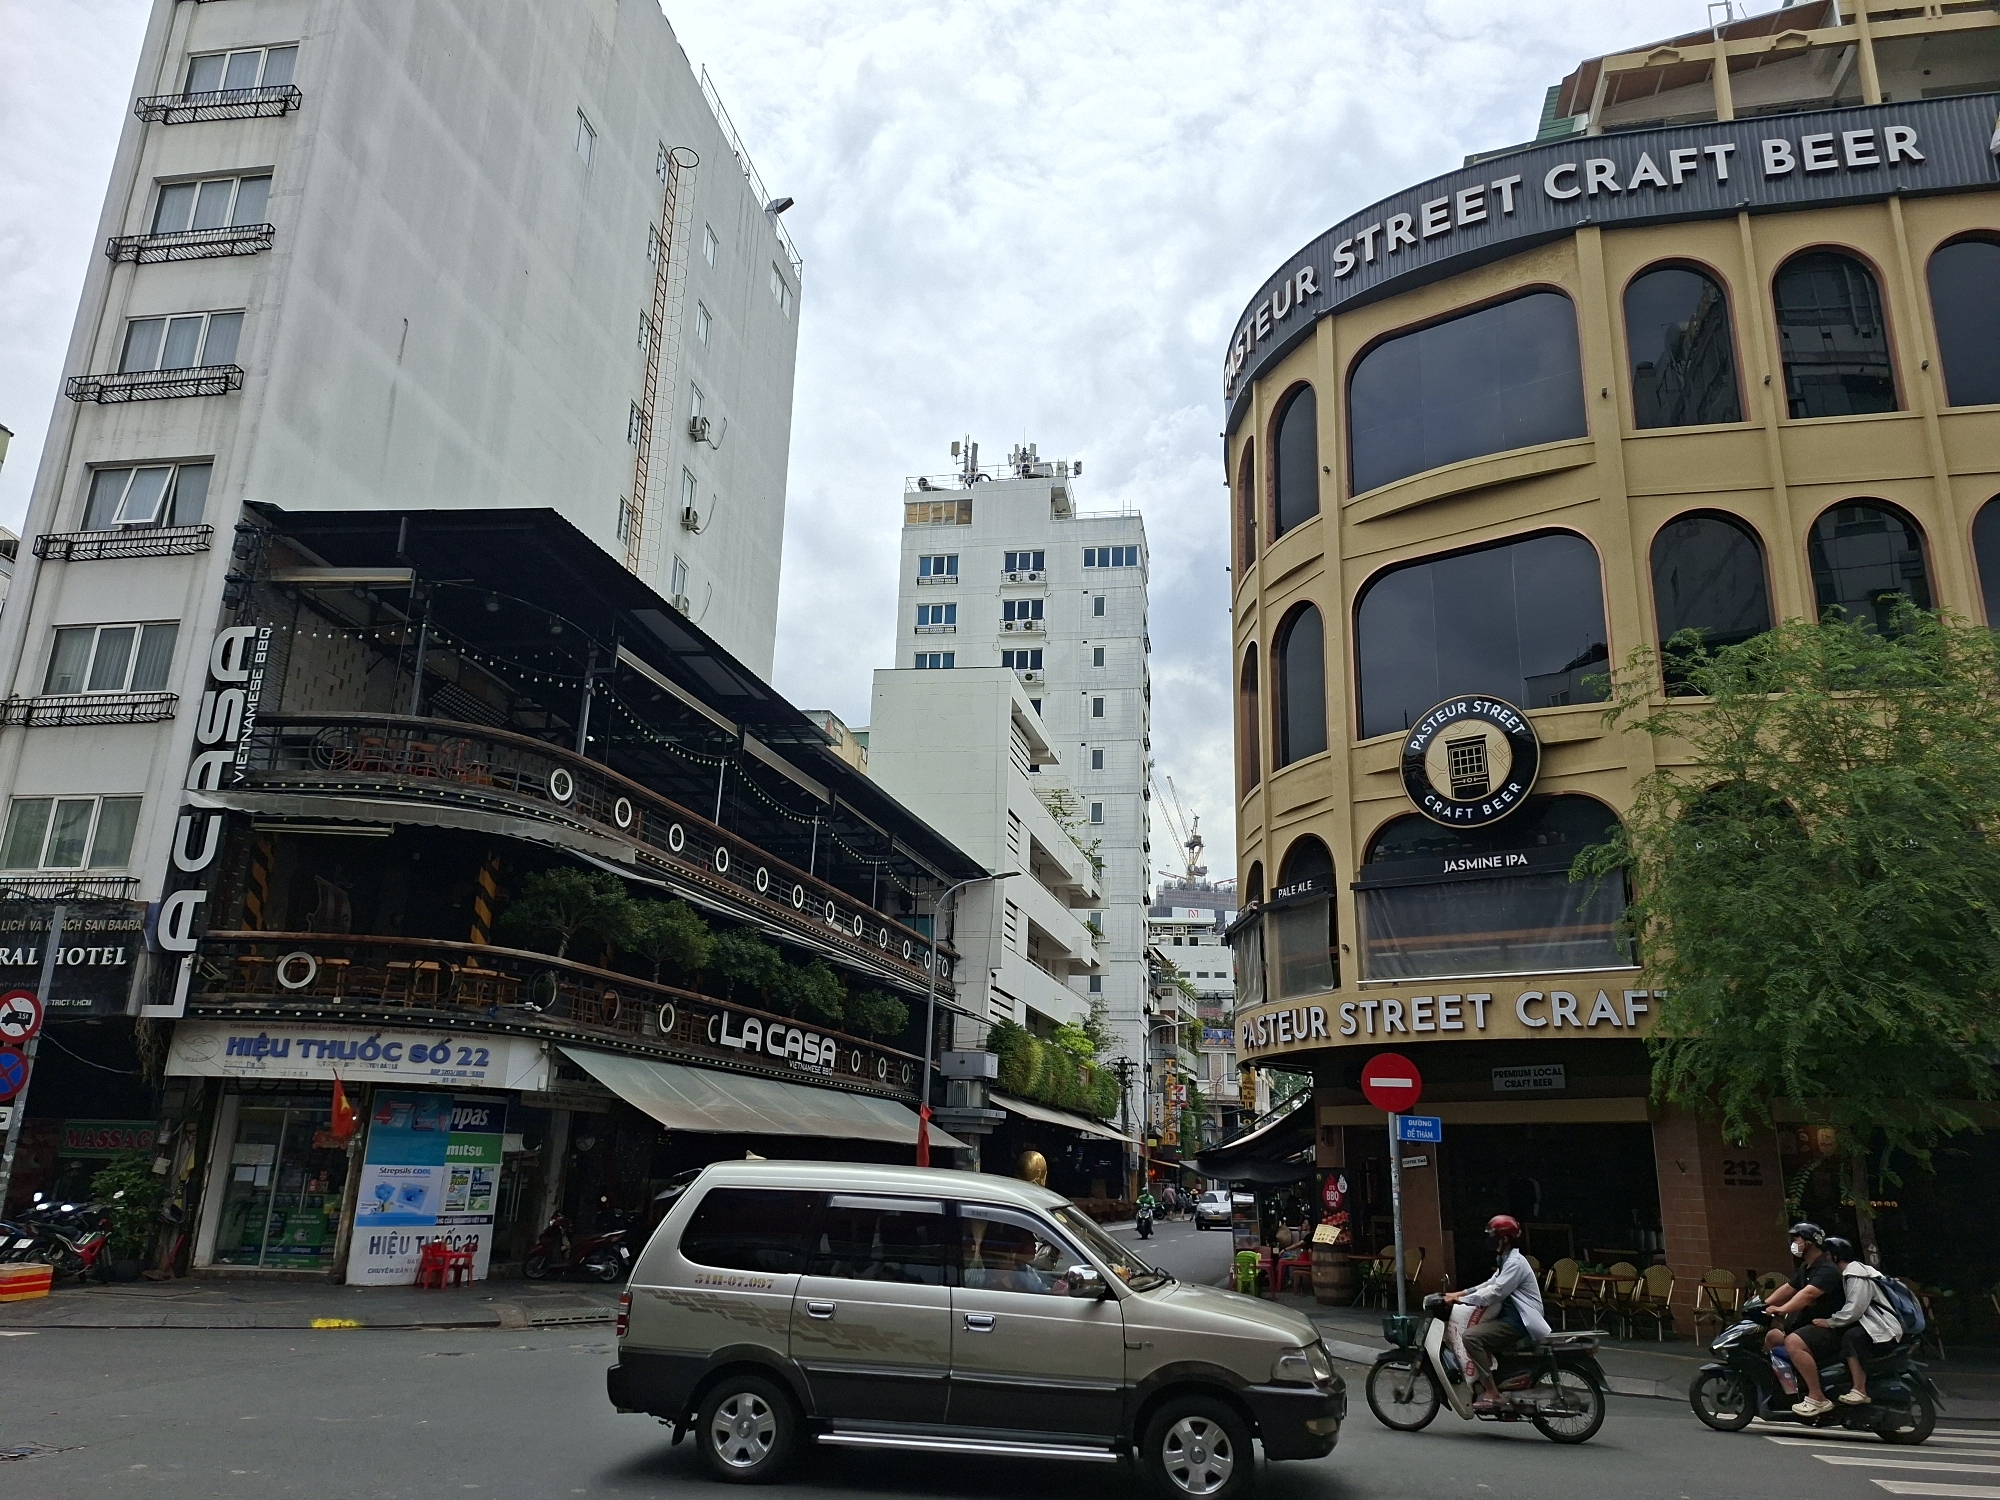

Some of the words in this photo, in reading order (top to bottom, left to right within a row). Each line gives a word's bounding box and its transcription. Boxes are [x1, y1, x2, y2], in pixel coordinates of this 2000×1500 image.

[1224, 265, 1319, 399] PASTEUR
[1332, 173, 1522, 278] STREET
[1543, 142, 1736, 200] CRAFT
[1760, 124, 1926, 176] BEER
[232, 668, 265, 784] VIETNAMESE
[254, 627, 273, 665] BBQ
[1410, 702, 1467, 751] PASTEUR
[1472, 700, 1526, 735] STREET
[1424, 794, 1474, 819] CRAFT
[1482, 781, 1522, 816] BEER
[1443, 855, 1502, 873] JASMINE
[1505, 853, 1528, 867] IPA
[1278, 885, 1296, 899] PALE
[1297, 880, 1312, 893] ALE
[84, 919, 105, 934] SẠN
[107, 919, 142, 931] BAARA
[140, 890, 207, 1019] LA
[1242, 1006, 1330, 1050] PASTEUR
[1338, 993, 1492, 1036] STREET
[1515, 988, 1668, 1028] CRAF
[226, 1032, 291, 1062] HIỆU
[296, 1032, 403, 1062] THUỐC
[408, 1038, 453, 1064] SỐ
[456, 1046, 490, 1067] 22
[719, 1010, 763, 1052] LA
[766, 1022, 837, 1068] CASA
[788, 1060, 822, 1075] VIETNAMESE
[822, 1067, 833, 1077] BBQ
[1493, 1068, 1532, 1079] PREMIUM
[1533, 1067, 1563, 1077] LOCAL
[1504, 1079, 1531, 1088] CRAFT
[1533, 1078, 1554, 1087] BEER
[378, 1166, 413, 1176] Strepsils
[412, 1167, 432, 1175] COOL
[1722, 1160, 1762, 1176] 212
[1326, 1190, 1340, 1202] BBQ
[368, 1231, 411, 1259] HIỆU
